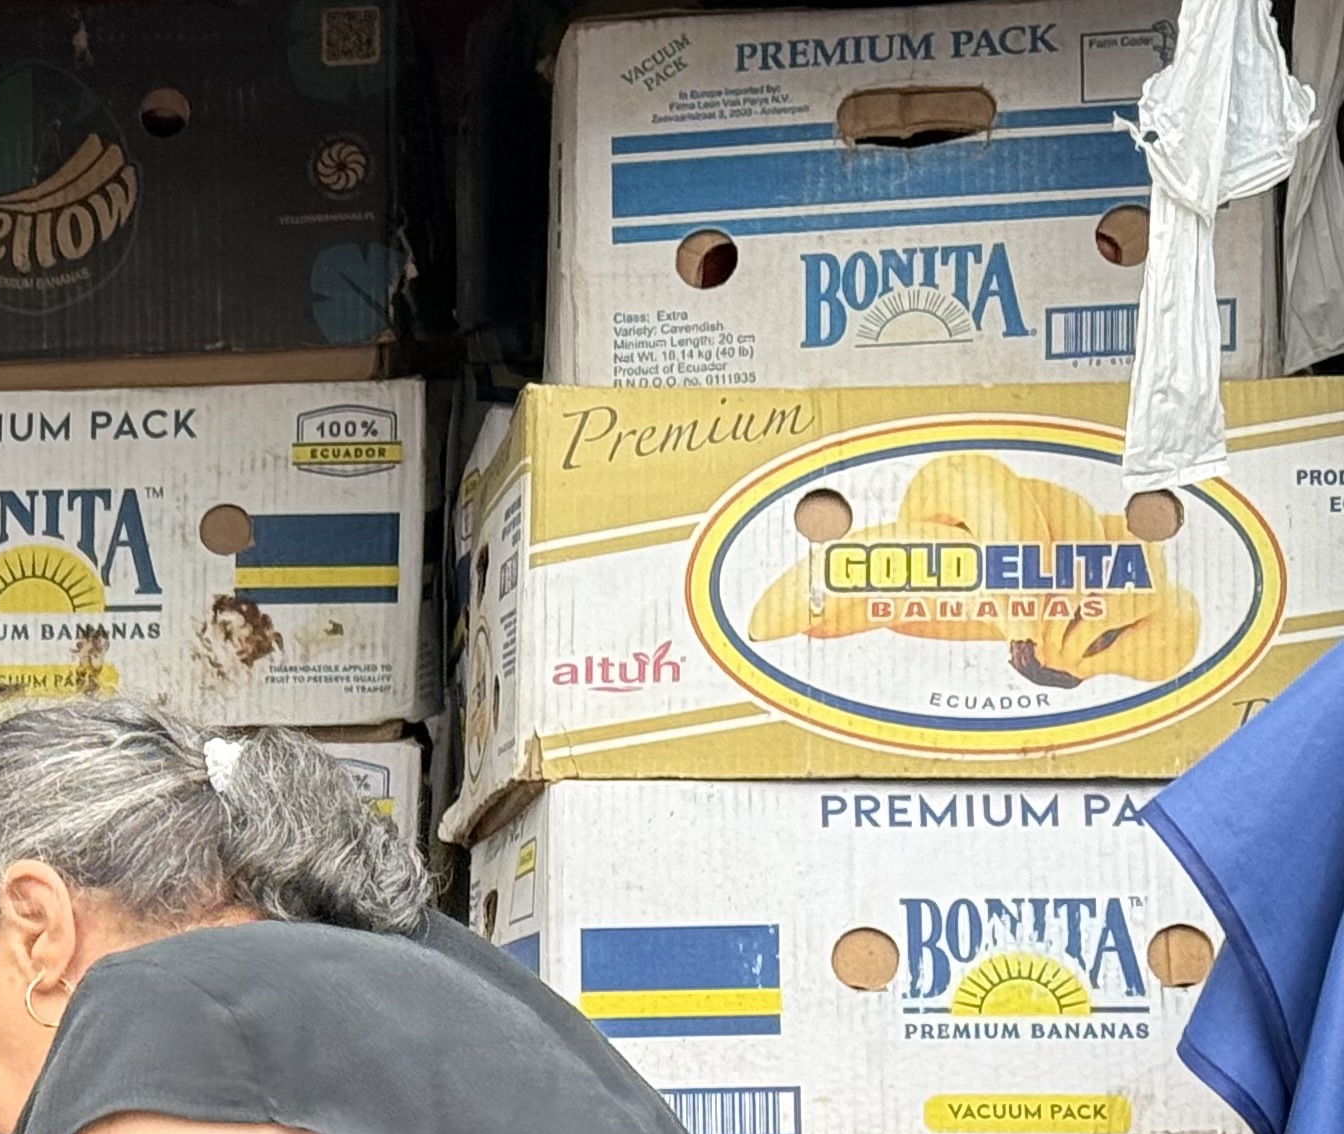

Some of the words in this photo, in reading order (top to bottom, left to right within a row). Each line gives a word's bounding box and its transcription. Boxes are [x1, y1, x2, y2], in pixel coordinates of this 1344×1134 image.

[620, 33, 692, 85] VACUUM
[735, 33, 934, 73] PREMIUM
[952, 24, 1058, 58] PACK
[642, 55, 690, 92] PACK
[800, 243, 1030, 349] BONITA
[656, 310, 689, 321] Extra
[660, 320, 725, 335] Cavendish
[613, 339, 667, 350] Minimum
[718, 333, 734, 345] 20
[613, 364, 660, 378] Product
[662, 363, 675, 374] of
[677, 361, 728, 375] Ecuador
[90, 408, 198, 440] PACK
[316, 419, 379, 439] 100%
[562, 402, 814, 472] Premium
[310, 446, 387, 460] ECUADOR
[1296, 468, 1344, 487] PROD
[870, 597, 1106, 621] BANANAS
[40, 622, 162, 642] BANANAS
[929, 690, 1051, 712] ECUADOR
[821, 793, 1059, 828] PREMIUM
[1084, 795, 1149, 829] PA
[900, 895, 1148, 1000] BONITA
[903, 1022, 1021, 1040] PREMIUM
[1030, 1022, 1150, 1040] BANANAS
[947, 1103, 1042, 1121] VACUUM
[1049, 1103, 1108, 1121] PACK
